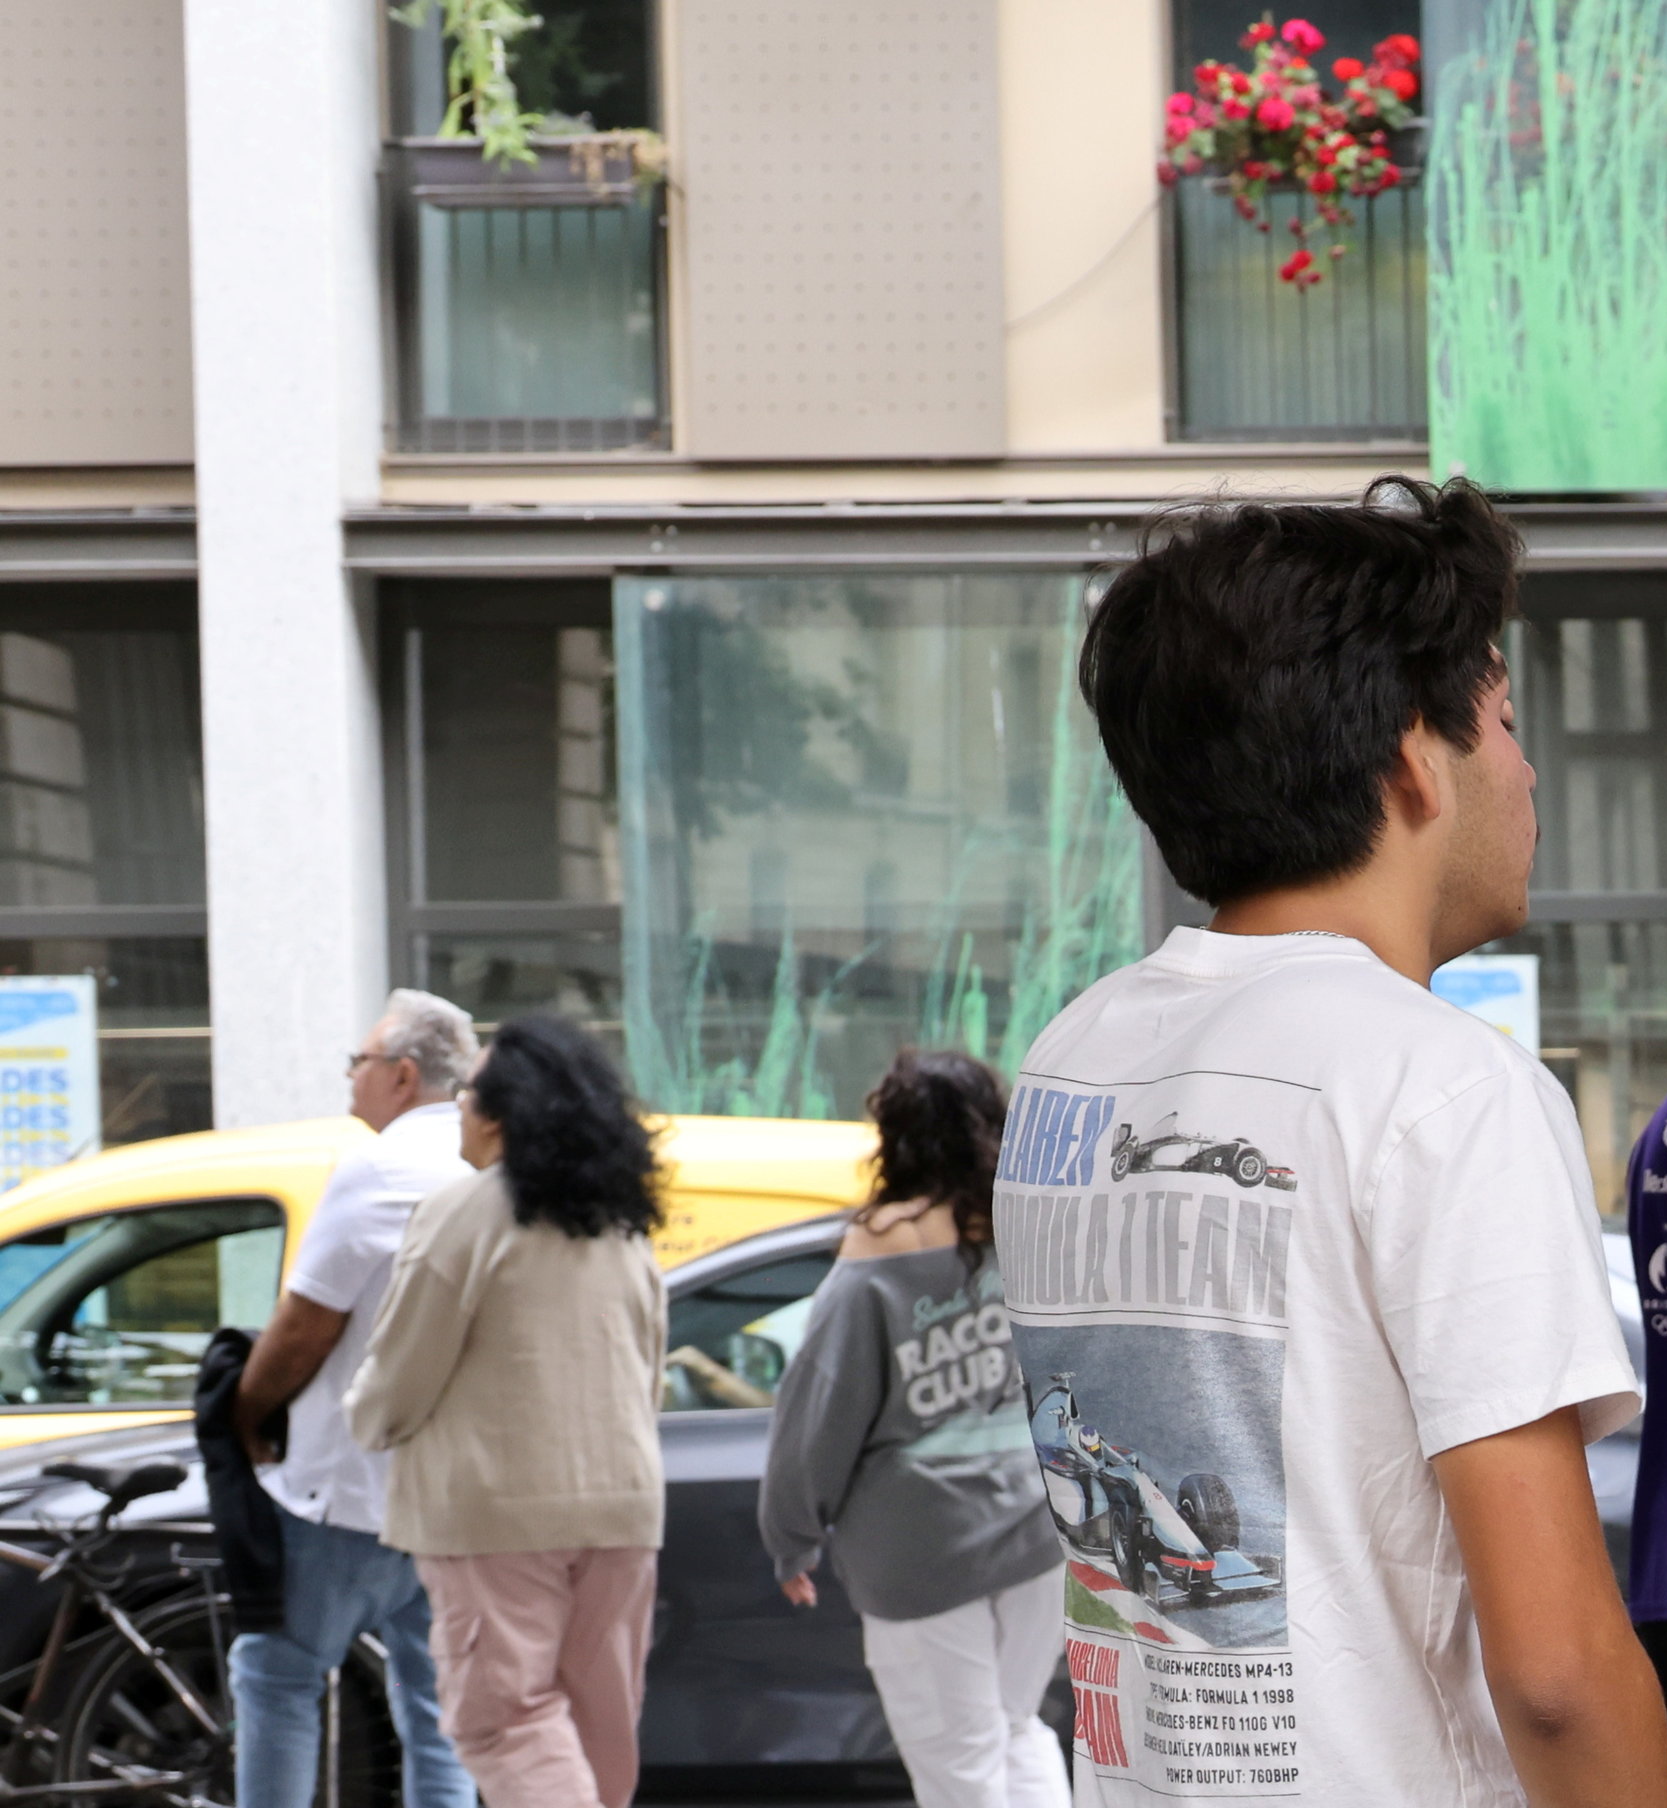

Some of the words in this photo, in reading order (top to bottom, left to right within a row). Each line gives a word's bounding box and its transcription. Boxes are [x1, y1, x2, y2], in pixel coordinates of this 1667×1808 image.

[1145, 1190, 1293, 1319] TEAM
[907, 1345, 1005, 1418] CLUB
[1245, 1662, 1294, 1679] MP4-13
[1196, 1688, 1249, 1705] FORMULA
[1252, 1690, 1259, 1704] 1
[1262, 1688, 1295, 1704] 1998
[1272, 1715, 1296, 1730] V10
[1253, 1741, 1297, 1757] NEWEY
[1196, 1768, 1246, 1785] OUTPUT:
[1250, 1768, 1299, 1784] 760BHP
